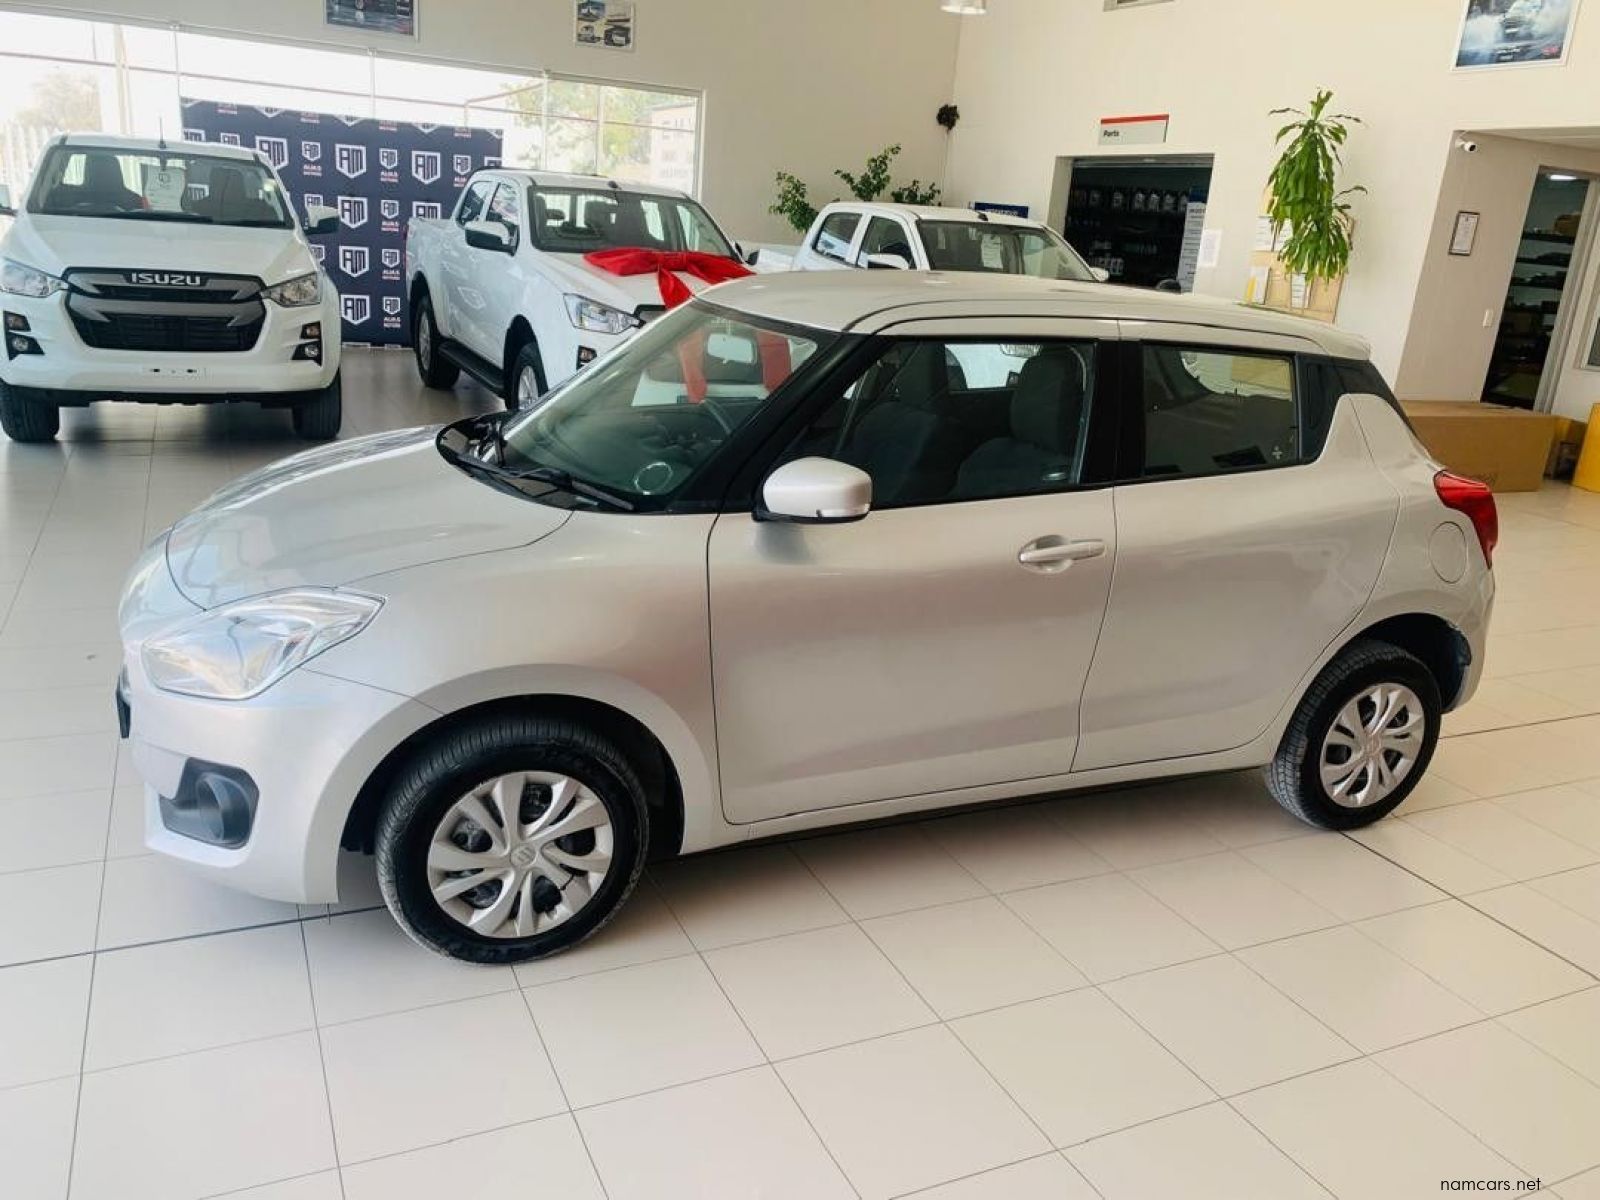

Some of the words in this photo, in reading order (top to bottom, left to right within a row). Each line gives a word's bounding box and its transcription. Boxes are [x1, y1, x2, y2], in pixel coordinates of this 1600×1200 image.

[338, 147, 364, 174] AM
[414, 154, 438, 181] AM
[341, 199, 364, 224] AM
[343, 249, 366, 274] AM
[131, 272, 202, 286] ISUZU
[344, 297, 367, 321] AM
